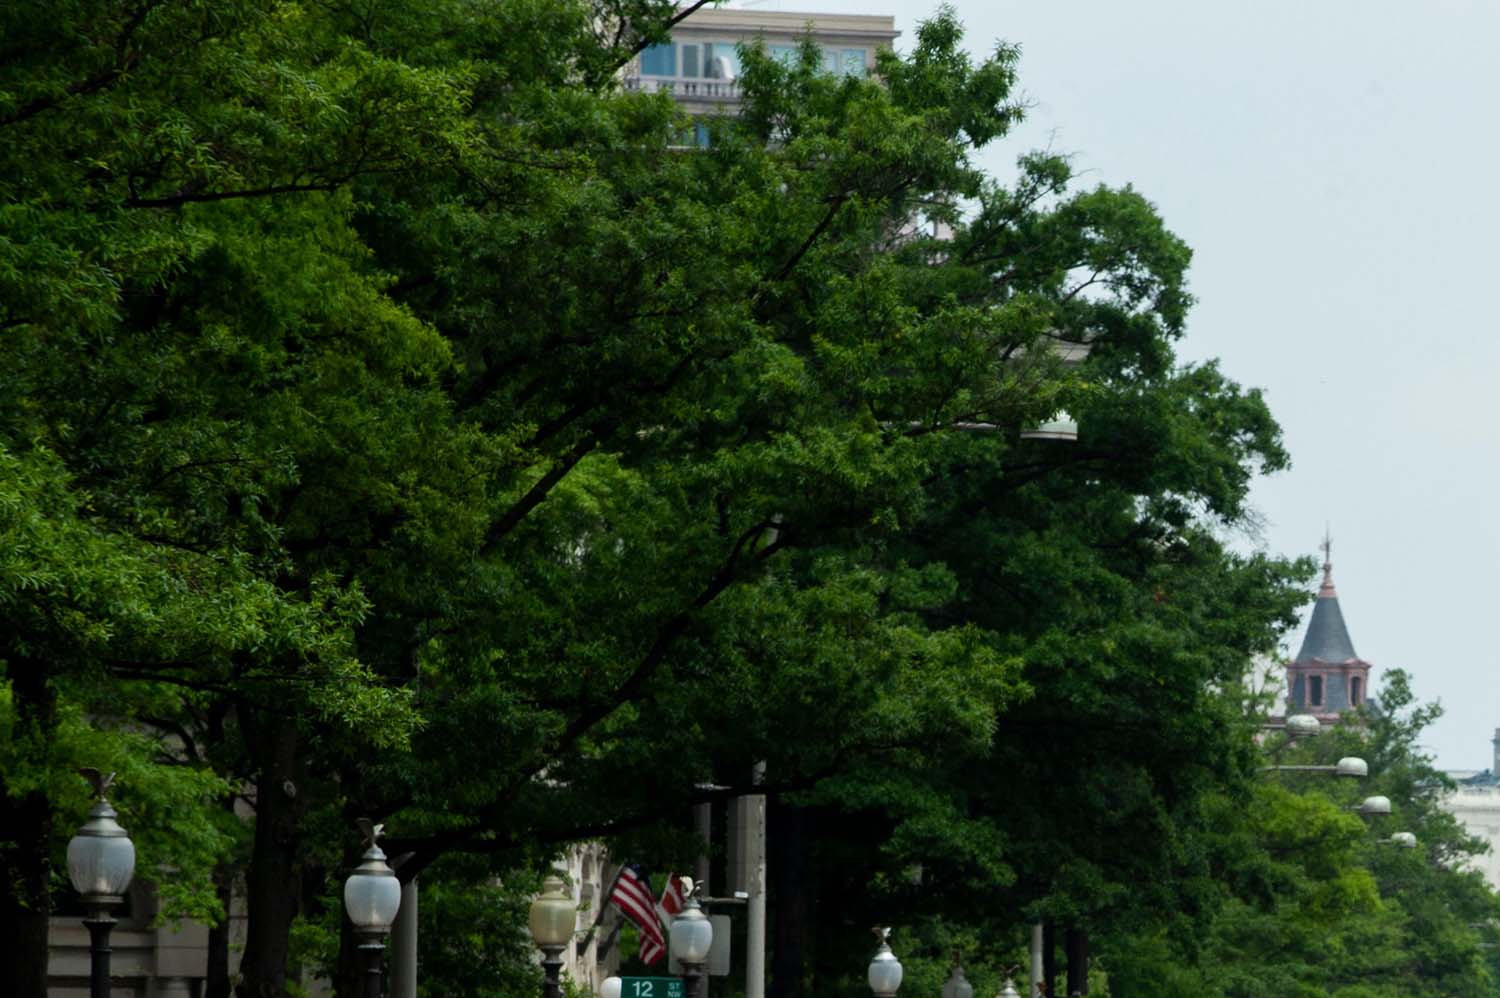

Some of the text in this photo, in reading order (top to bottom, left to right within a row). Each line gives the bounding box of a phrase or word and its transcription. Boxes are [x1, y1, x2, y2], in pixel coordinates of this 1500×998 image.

[632, 981, 681, 998] 12 ST
[667, 990, 682, 998] NW
